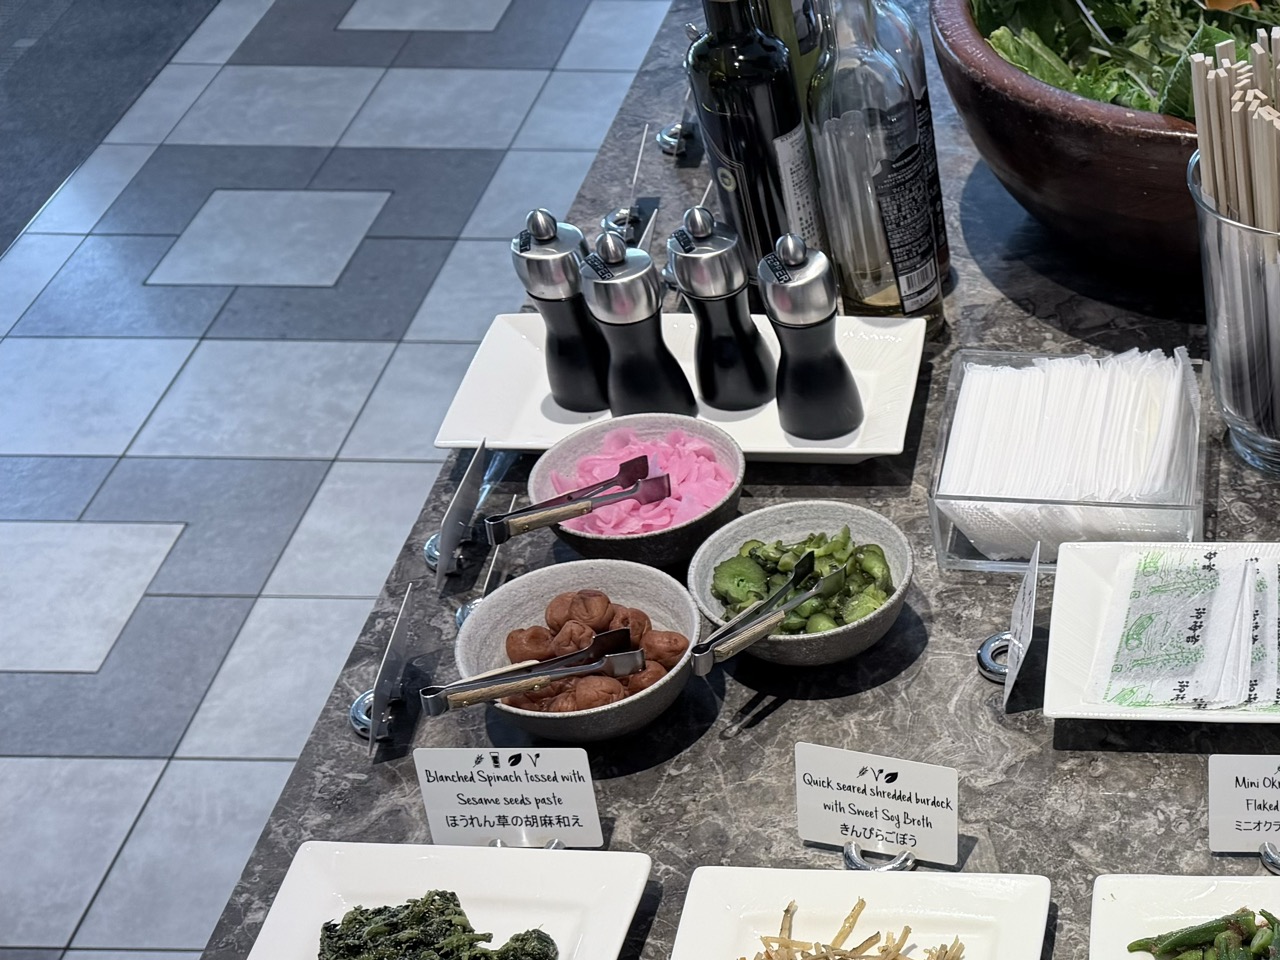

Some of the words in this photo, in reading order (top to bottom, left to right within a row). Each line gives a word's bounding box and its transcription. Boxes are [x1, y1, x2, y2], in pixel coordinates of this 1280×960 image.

[764, 254, 790, 283] PEPPER
[425, 769, 476, 783] Blanched
[477, 770, 522, 787] Spinach
[525, 771, 559, 783] tossed
[561, 770, 586, 783] with
[1234, 776, 1259, 789] Mini
[456, 793, 500, 805] Sesame
[503, 794, 532, 805] seeds
[535, 792, 563, 809] paste
[803, 772, 835, 790] Quick
[836, 782, 867, 796] seared
[870, 786, 912, 803] shredded
[915, 792, 953, 811] burdock
[823, 800, 845, 813] with
[848, 803, 879, 820] Sweet
[882, 808, 900, 829] Soy
[903, 812, 933, 829] Broth
[1246, 799, 1279, 812] Flaked
[445, 815, 583, 828] ほうれん草の胡麻和え
[840, 823, 917, 847] きんぴらごぼう
